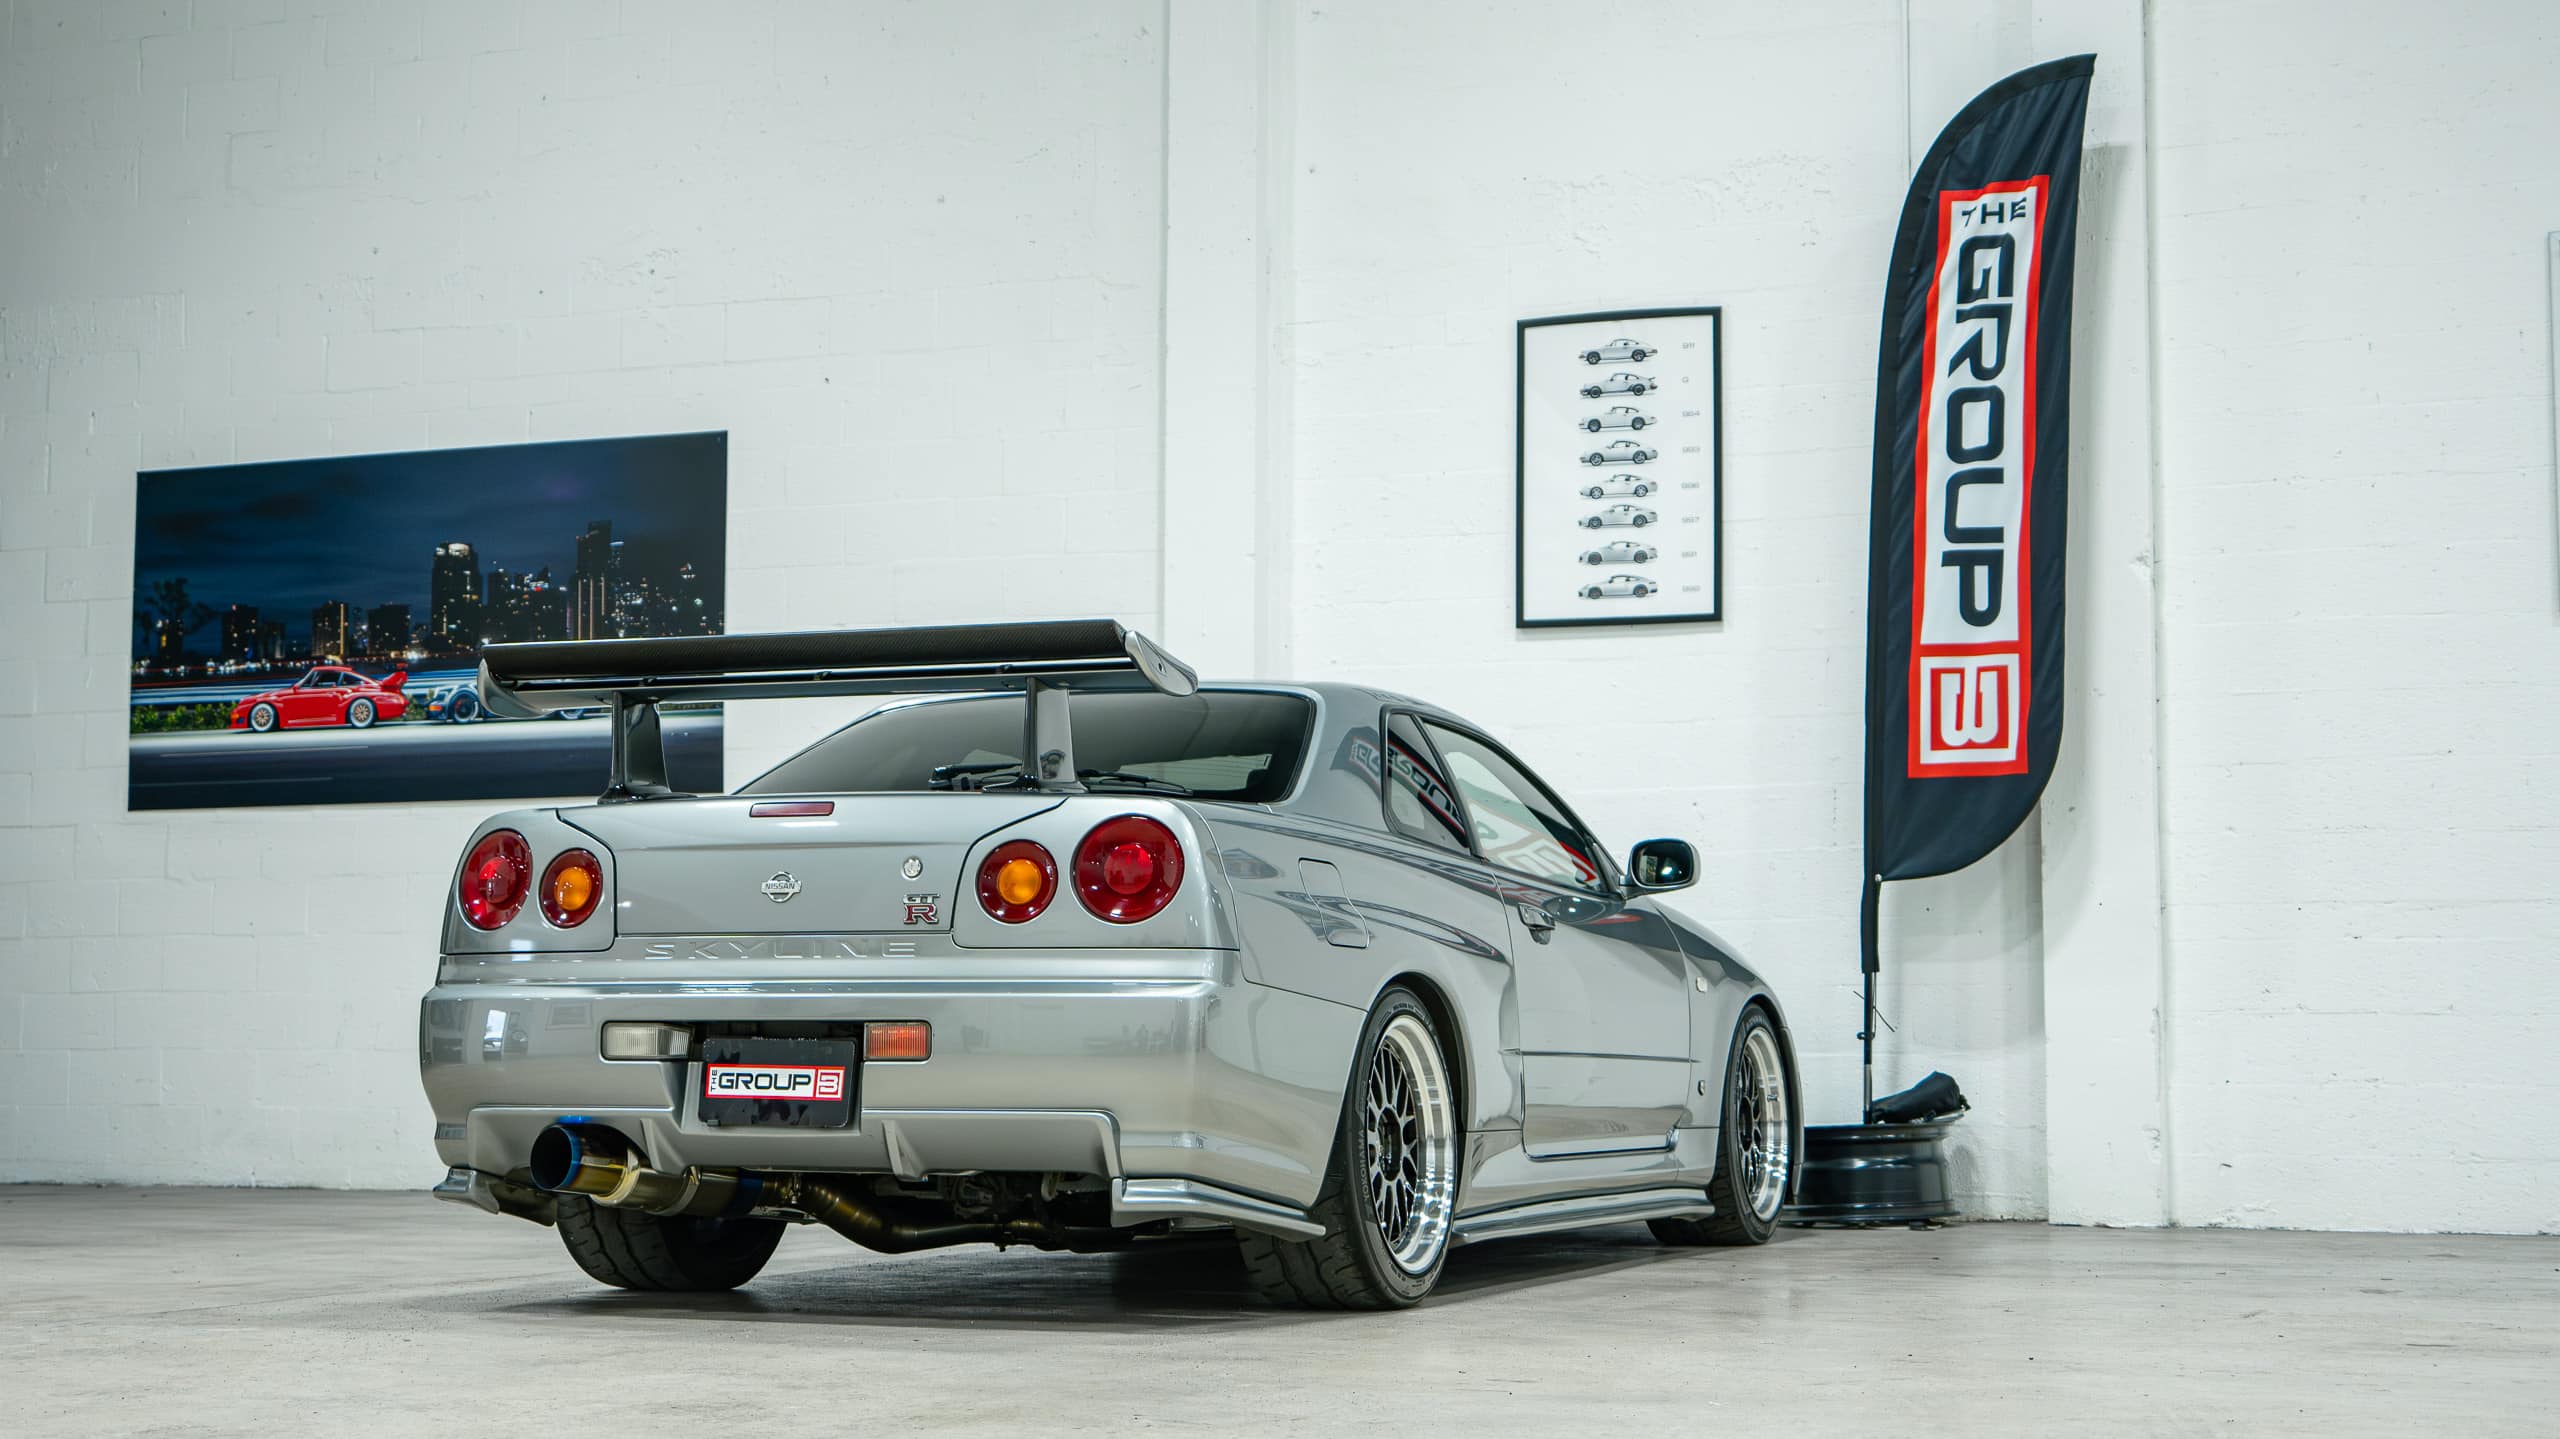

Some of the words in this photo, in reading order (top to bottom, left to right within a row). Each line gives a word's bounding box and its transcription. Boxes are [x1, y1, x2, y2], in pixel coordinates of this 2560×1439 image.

[1961, 196, 2027, 227] THE
[1942, 232, 2016, 627] GROUP
[764, 882, 796, 891] NISSAN
[902, 893, 941, 904] GT
[903, 903, 940, 925] R
[643, 940, 916, 960] SKYLINE
[710, 1069, 719, 1092] THE
[718, 1072, 812, 1091] GROUP
